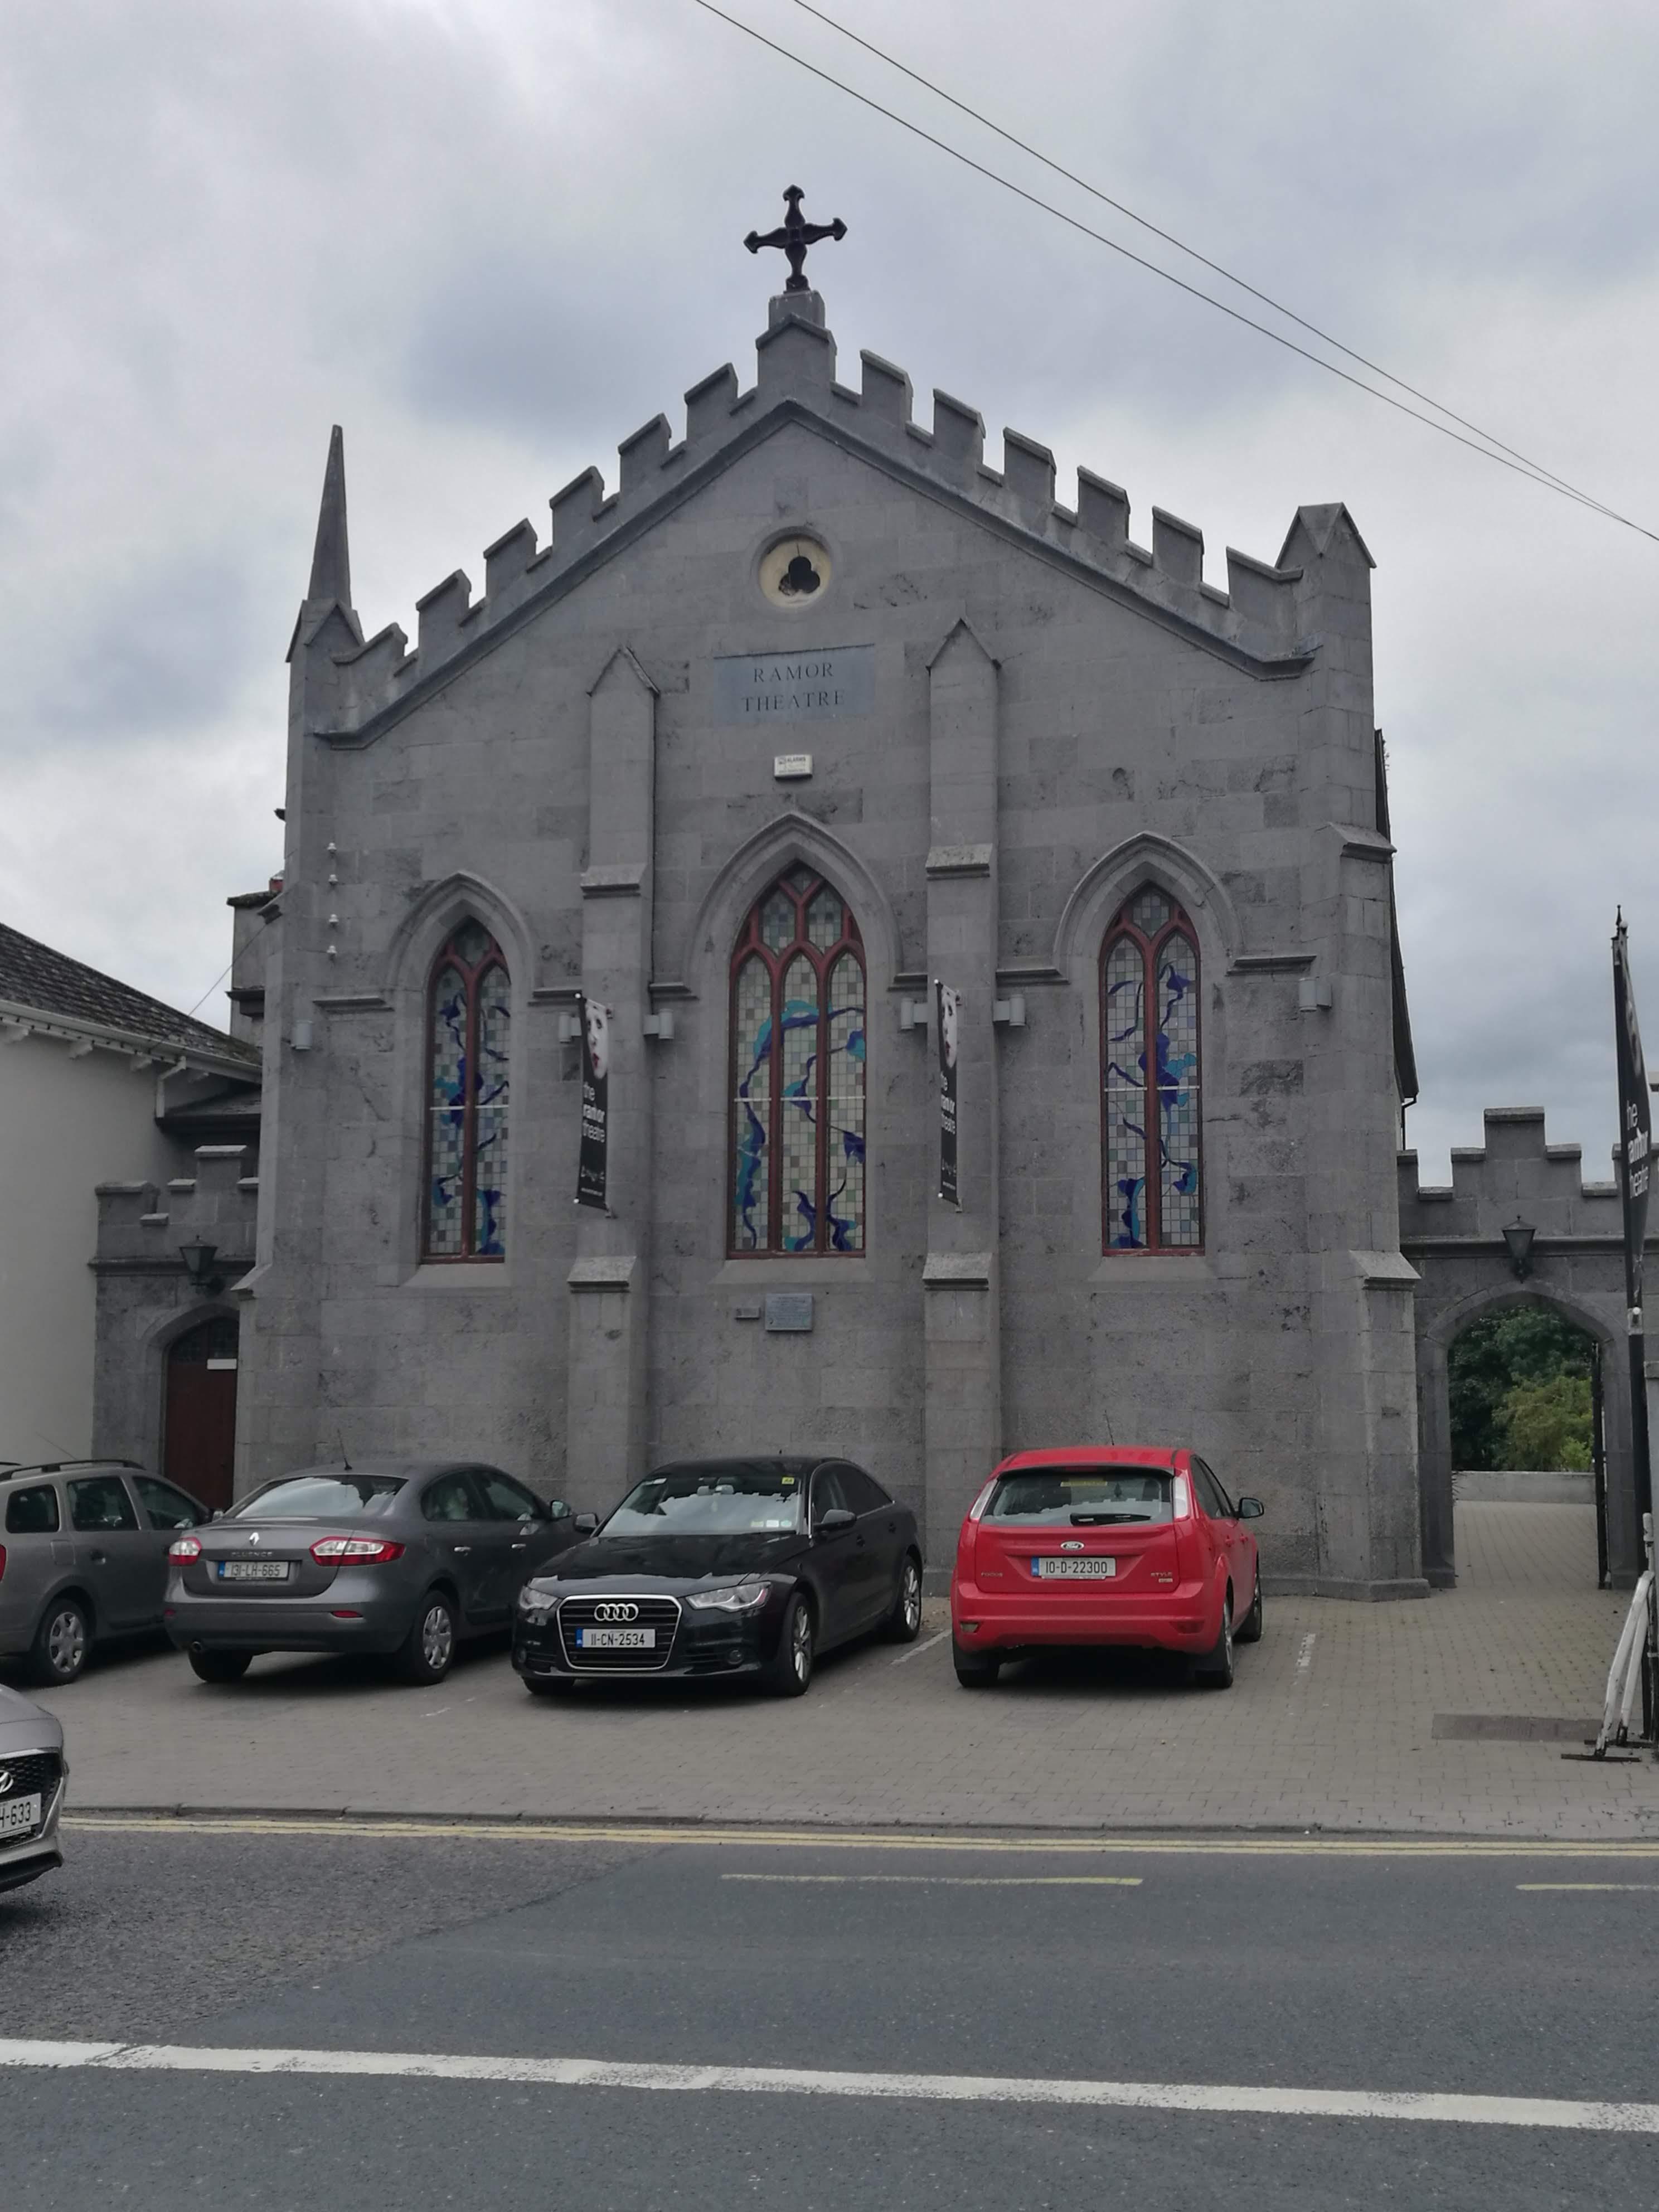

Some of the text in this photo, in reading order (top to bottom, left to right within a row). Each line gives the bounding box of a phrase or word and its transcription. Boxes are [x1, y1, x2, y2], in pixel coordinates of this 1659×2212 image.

[754, 662, 833, 683] RAMOR
[741, 688, 845, 712] THEATRE
[1627, 1099, 1638, 1131] he
[1627, 1127, 1648, 1164] amor
[1629, 1163, 1648, 1199] heatre
[231, 1564, 280, 1576] 131-LH-665
[1046, 1561, 1107, 1574] 10-D-22300
[591, 1633, 645, 1646] 11-CN-2534
